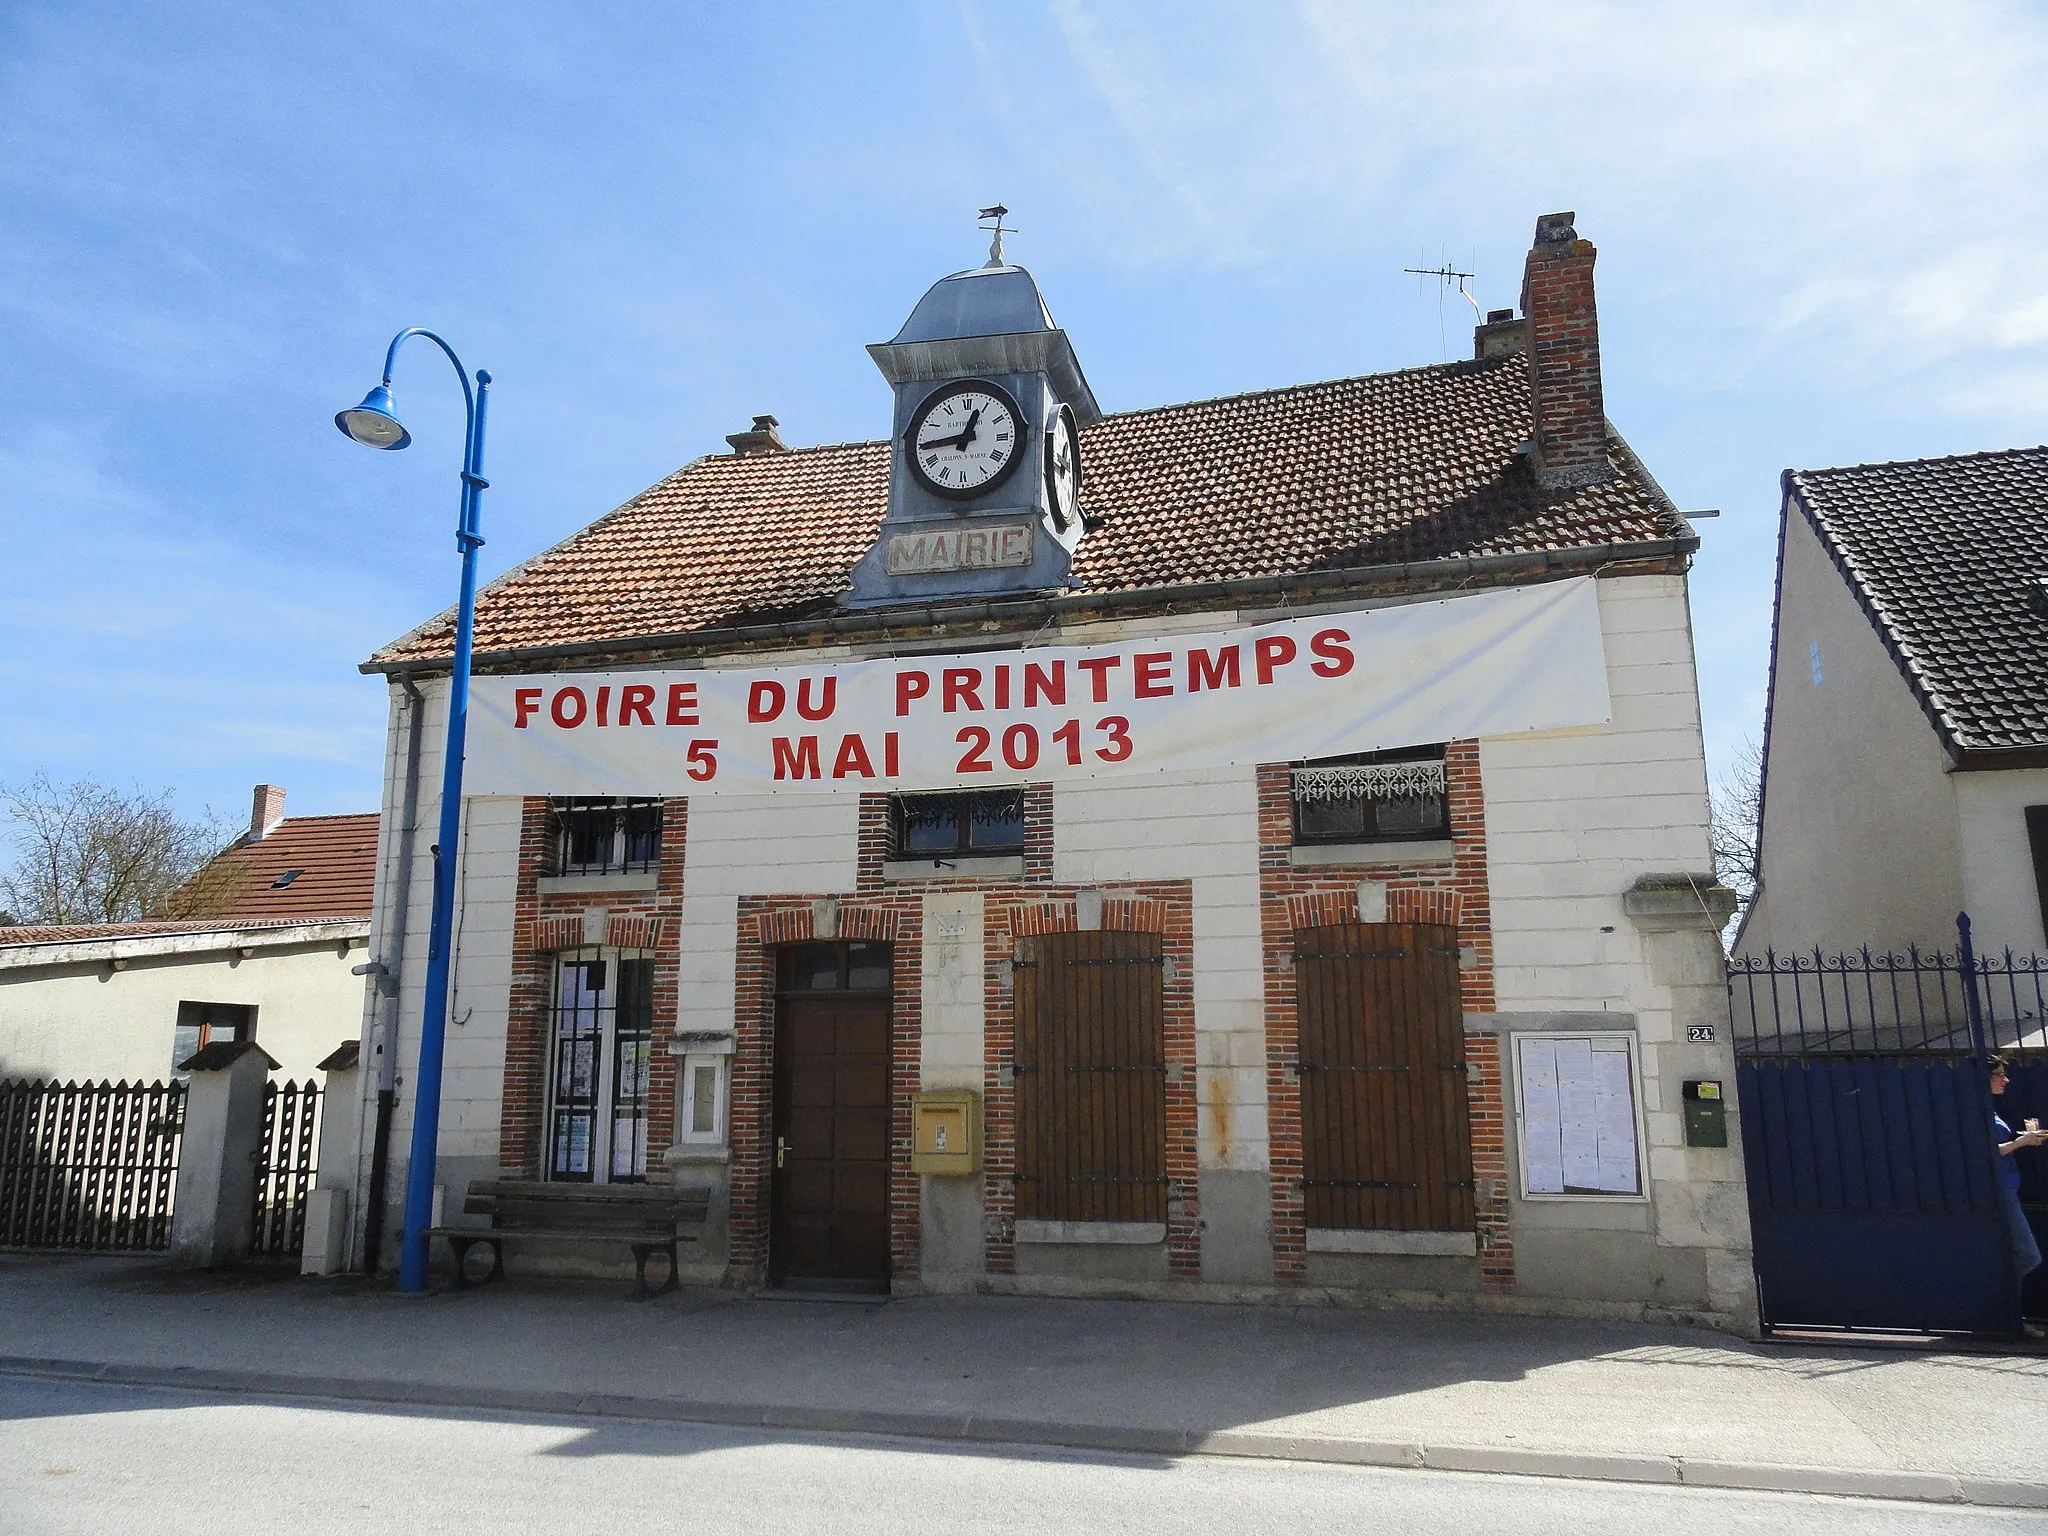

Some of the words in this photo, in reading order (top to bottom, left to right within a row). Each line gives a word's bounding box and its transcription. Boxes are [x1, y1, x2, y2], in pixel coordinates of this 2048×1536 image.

[996, 432, 1009, 442] III
[893, 529, 1024, 568] MAIRIE
[515, 683, 699, 729] FOIRE
[748, 676, 837, 723] DU
[896, 629, 1355, 716] PRINTEMPS
[687, 739, 719, 782] 5
[772, 731, 899, 781] MAI
[956, 716, 1134, 773] 2013
[1691, 1028, 1711, 1040] 24
